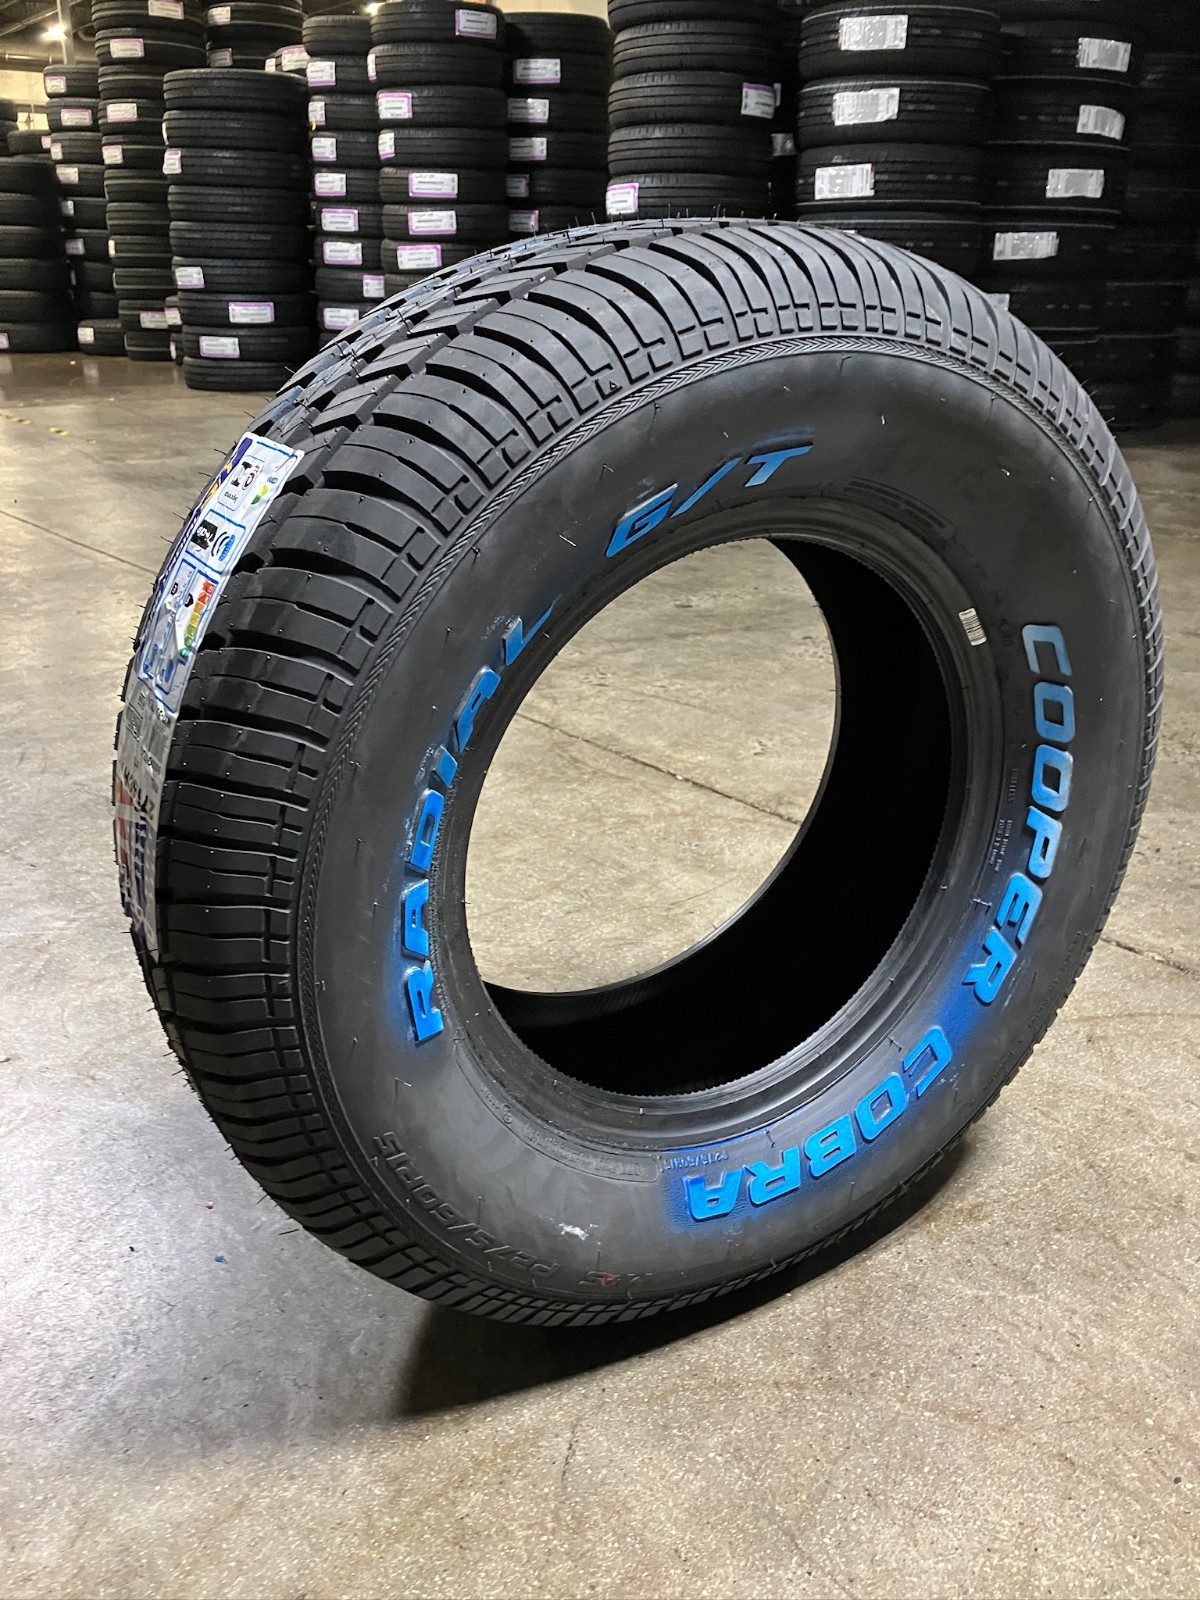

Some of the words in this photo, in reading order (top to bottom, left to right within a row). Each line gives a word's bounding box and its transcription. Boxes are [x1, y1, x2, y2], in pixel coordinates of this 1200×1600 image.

[606, 445, 812, 557] G/T
[402, 605, 554, 1041] RADIAL
[963, 624, 1075, 1003] COOPER
[683, 1026, 953, 1221] COBRA
